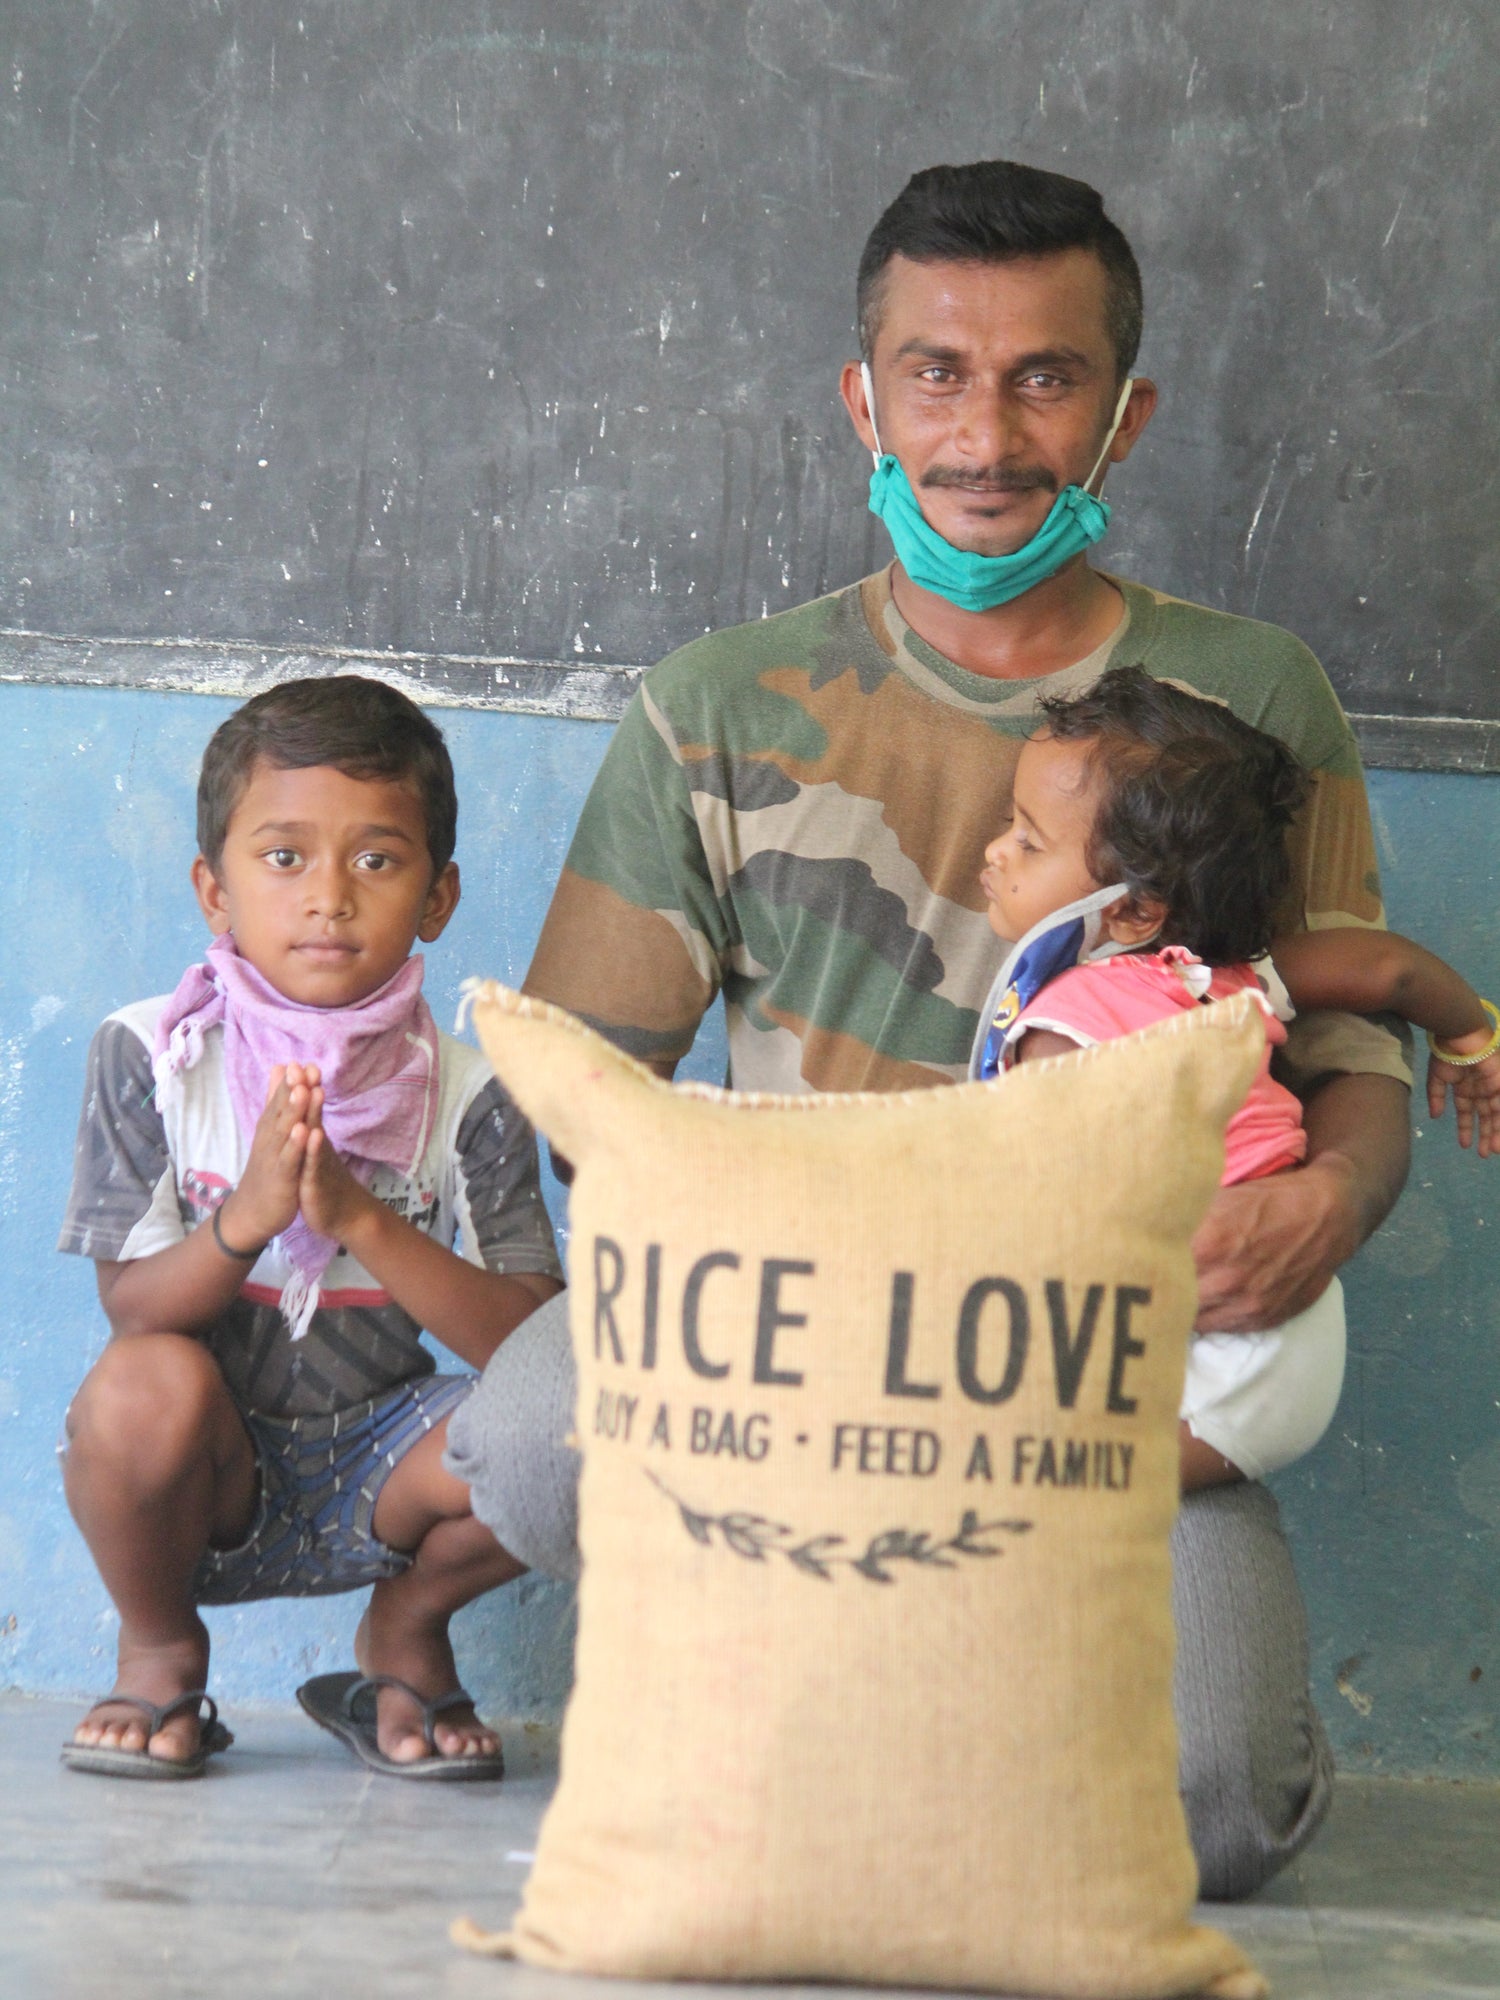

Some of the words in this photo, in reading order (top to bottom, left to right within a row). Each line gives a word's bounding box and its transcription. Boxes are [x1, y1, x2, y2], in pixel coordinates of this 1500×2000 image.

[593, 1235, 816, 1386] RICE
[883, 1271, 1152, 1414] LOVE
[648, 1402, 671, 1450] A
[691, 1408, 771, 1461] BAG
[831, 1424, 940, 1478] FEED
[964, 1434, 992, 1482] A
[1012, 1435, 1134, 1490] FAMILY
